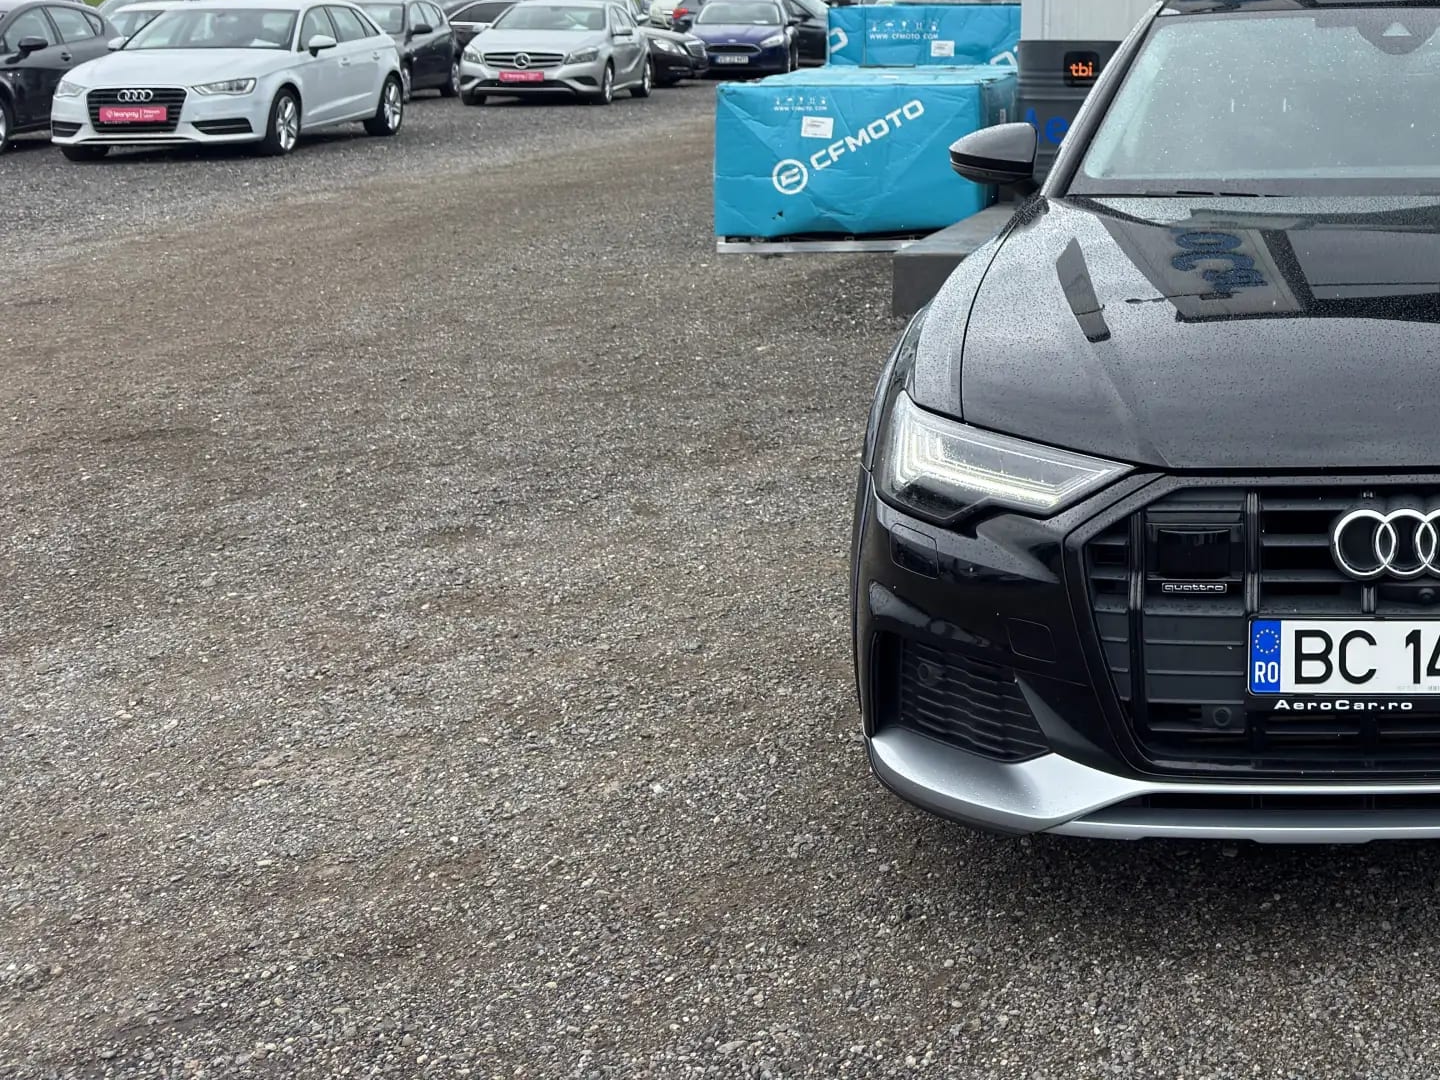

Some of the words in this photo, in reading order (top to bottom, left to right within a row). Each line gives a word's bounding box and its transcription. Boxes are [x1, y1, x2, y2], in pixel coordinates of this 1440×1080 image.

[1069, 61, 1094, 77] tbi
[810, 99, 925, 171] CFMOTO
[1164, 583, 1225, 593] quattro
[1293, 628, 1378, 685] BC
[1254, 661, 1279, 684] RO
[1273, 699, 1414, 711] AeroCar.ro
